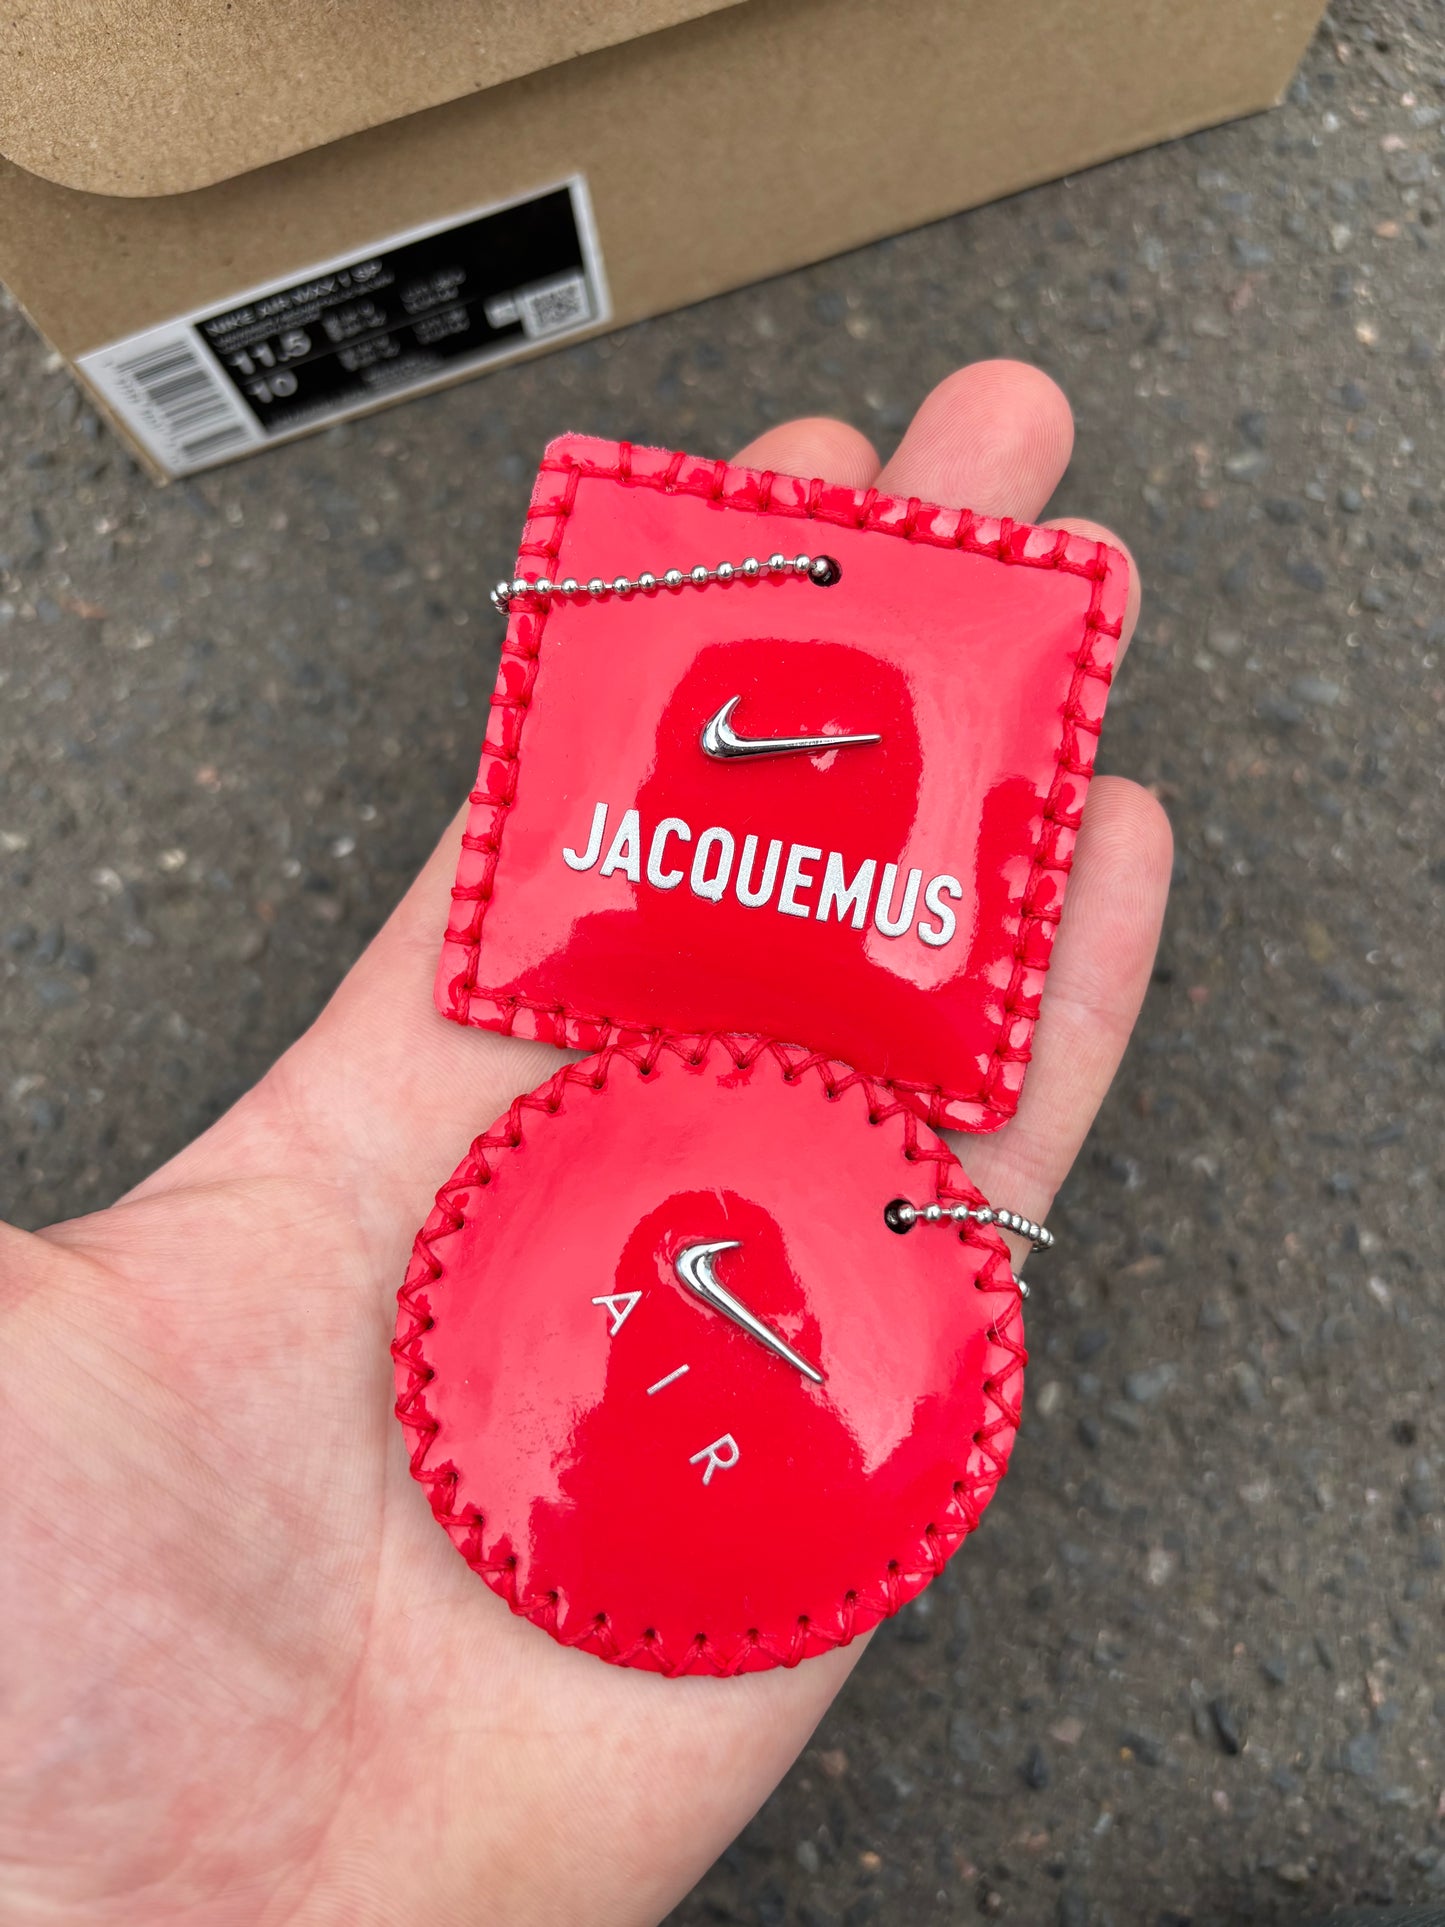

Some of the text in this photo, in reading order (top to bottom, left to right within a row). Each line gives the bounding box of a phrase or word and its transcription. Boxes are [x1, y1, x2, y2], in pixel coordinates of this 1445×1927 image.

[229, 329, 312, 375] 11.5
[250, 370, 298, 403] 10
[562, 801, 963, 947] JACQUEMUS
[591, 1289, 741, 1486] AIR
